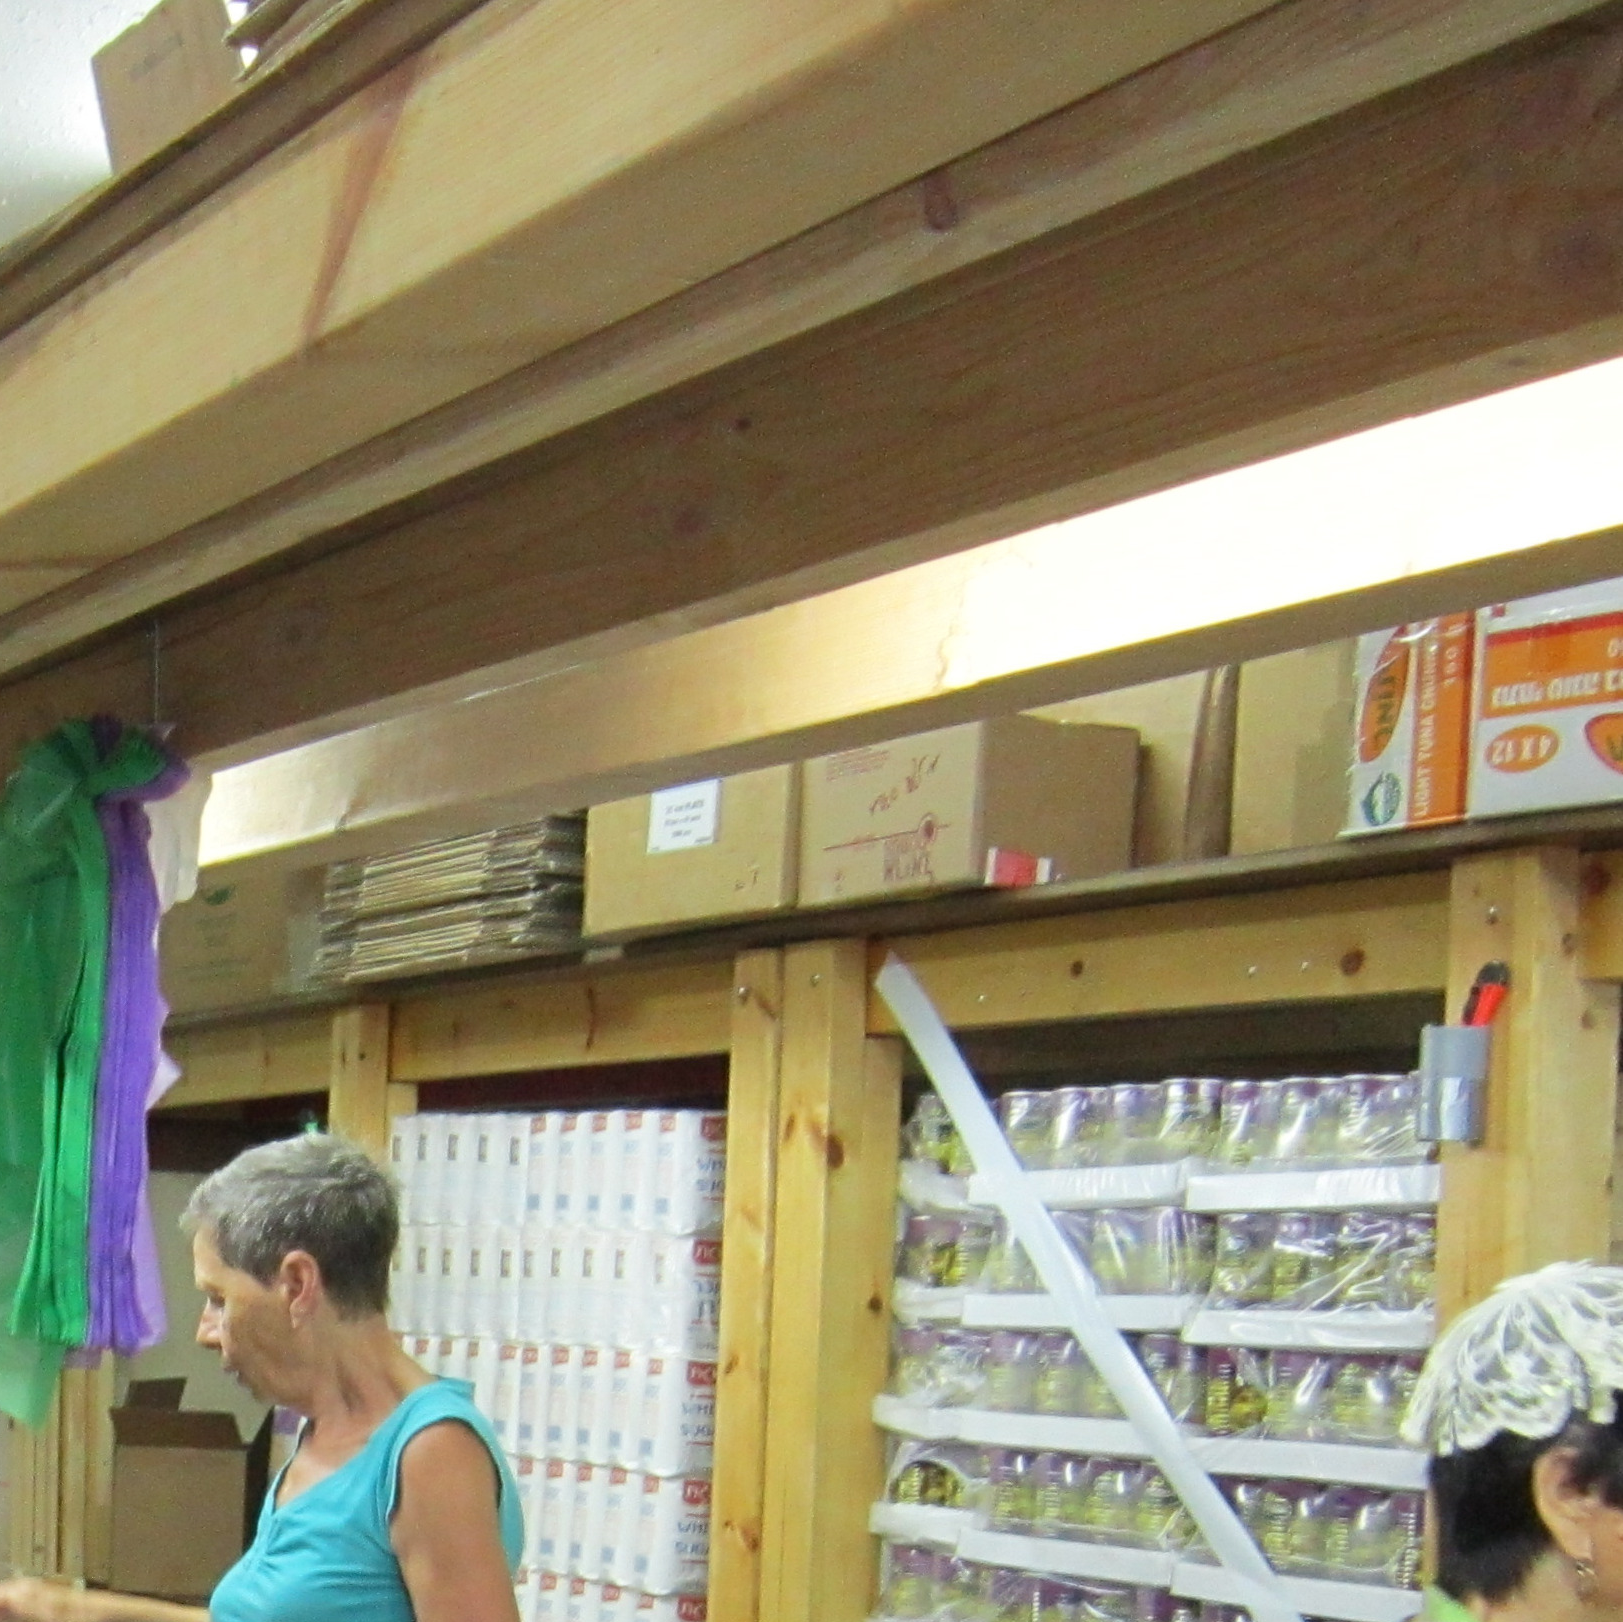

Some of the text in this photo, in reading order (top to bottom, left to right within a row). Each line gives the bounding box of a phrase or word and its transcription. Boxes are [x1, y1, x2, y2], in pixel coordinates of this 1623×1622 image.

[1418, 715, 1435, 760] TUNA
[1414, 766, 1433, 817] LIGHT
[682, 1402, 713, 1415] WHI
[677, 1521, 709, 1534] WHI
[675, 1541, 709, 1555] SUG
